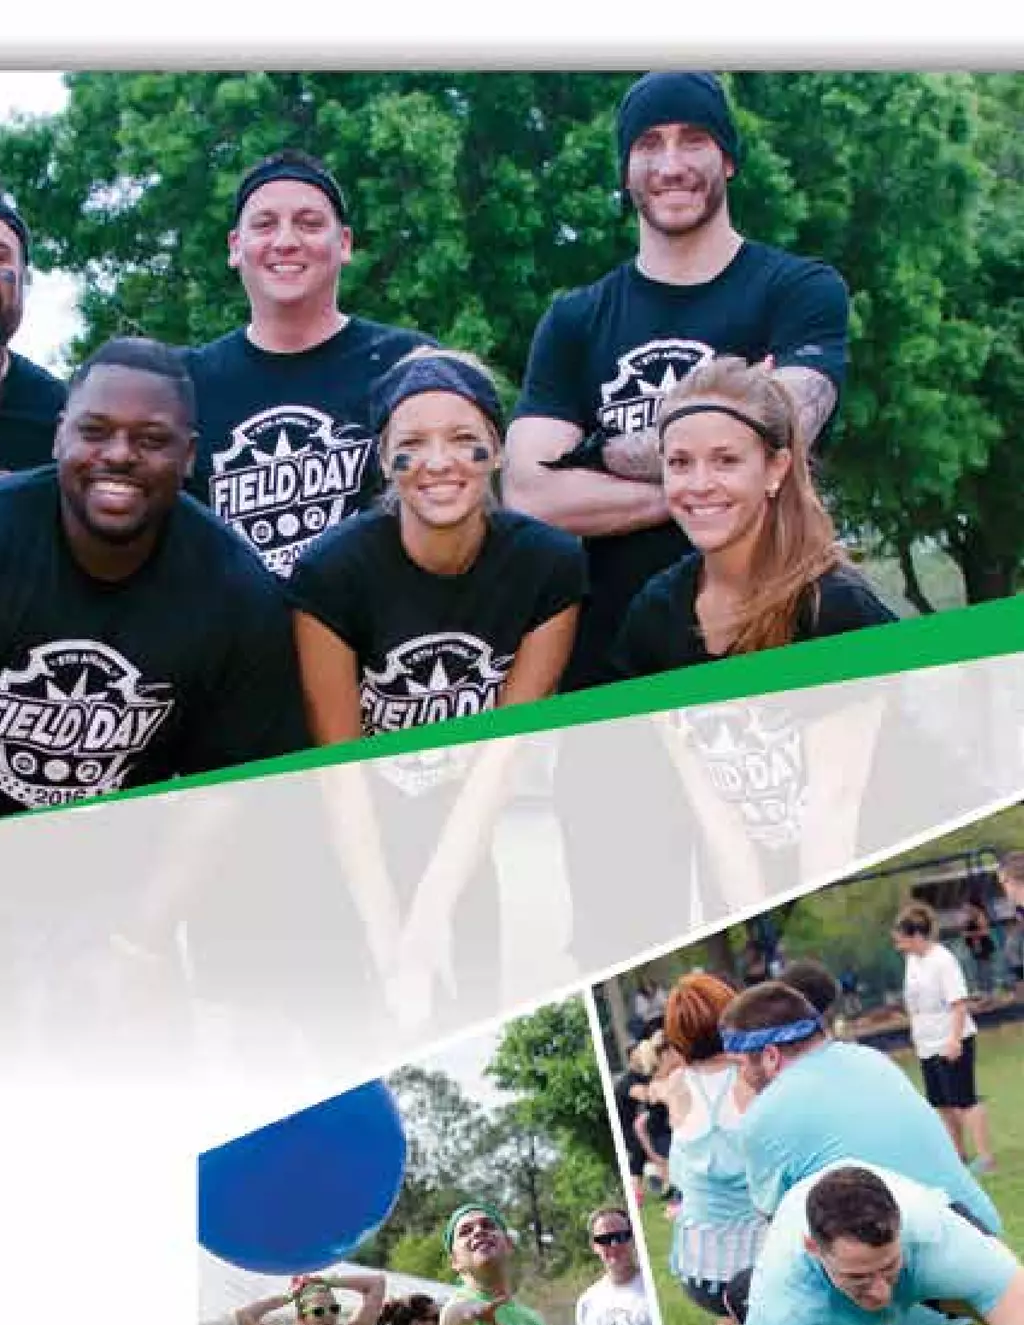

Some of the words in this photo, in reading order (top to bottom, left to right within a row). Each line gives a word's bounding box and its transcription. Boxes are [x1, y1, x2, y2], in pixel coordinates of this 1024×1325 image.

[215, 465, 296, 517] FIELD
[304, 448, 361, 498] DAY
[83, 704, 163, 750] DAY
